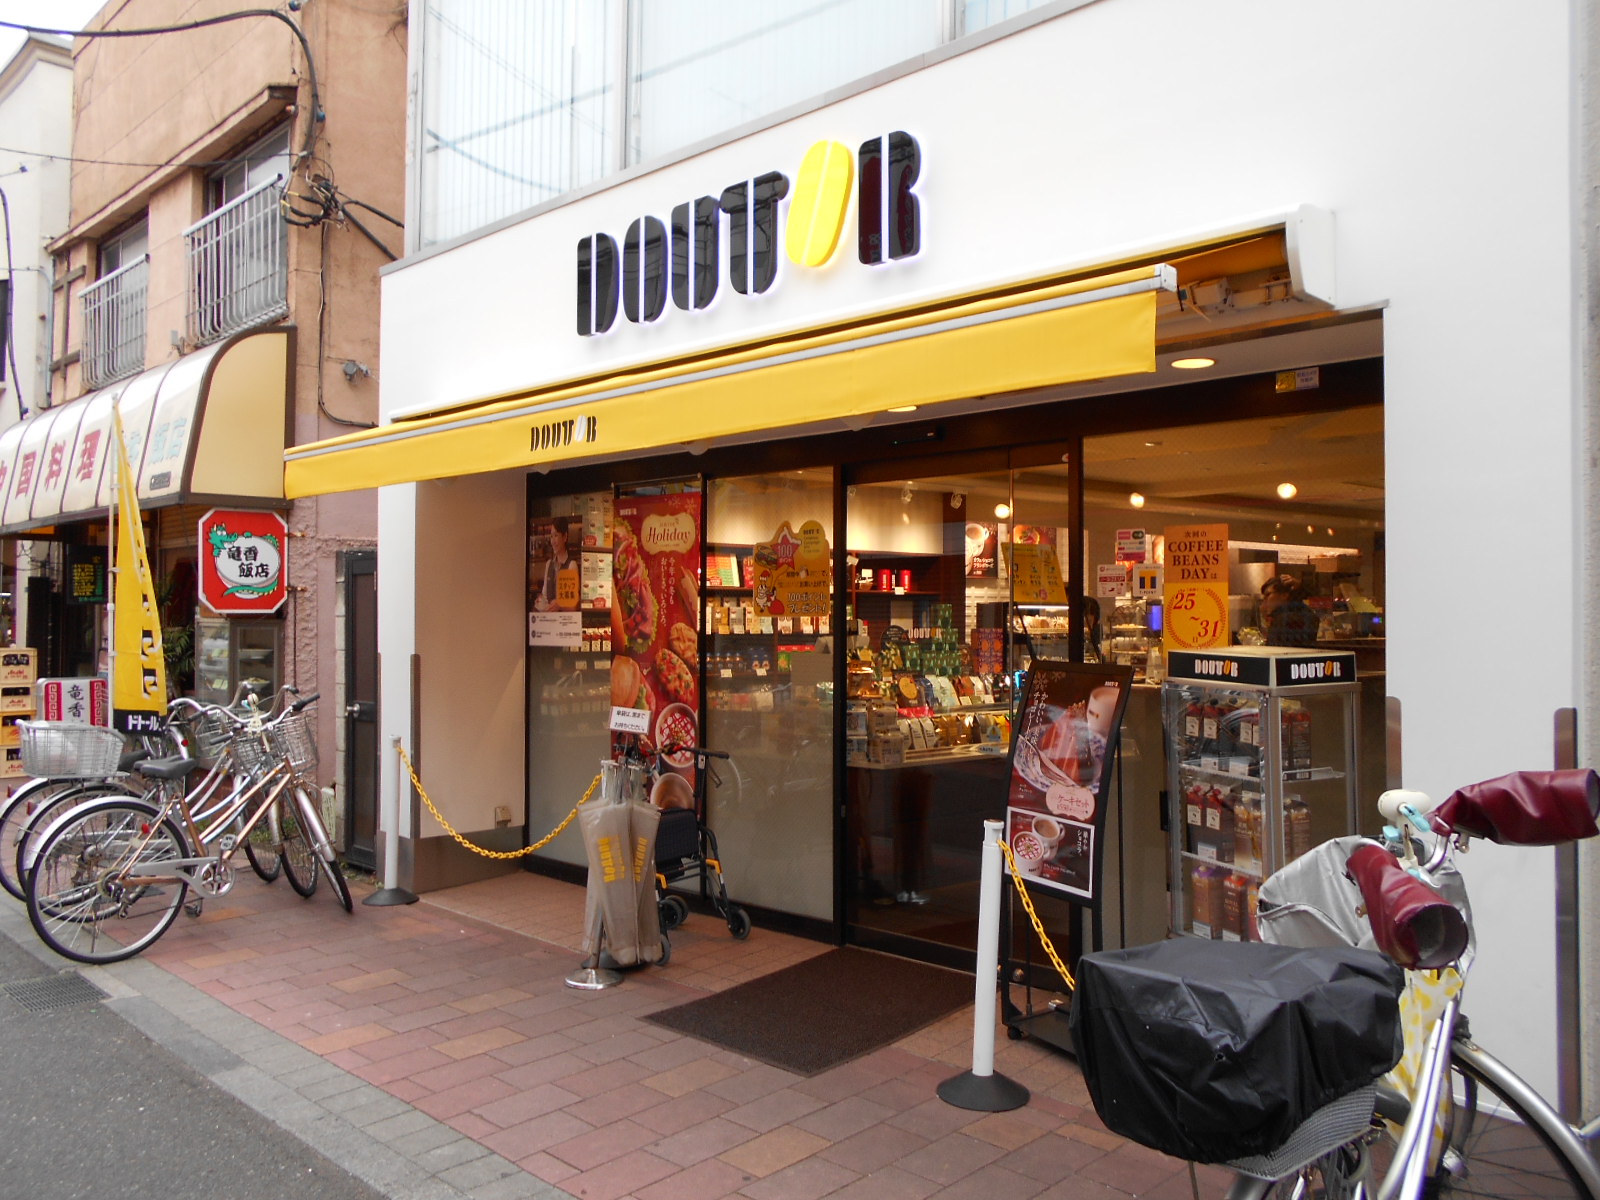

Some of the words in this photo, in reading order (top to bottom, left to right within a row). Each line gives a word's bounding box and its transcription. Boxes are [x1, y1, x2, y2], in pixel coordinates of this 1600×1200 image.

[577, 130, 922, 336] DOUTOR
[530, 415, 597, 452] DOUTOR
[647, 527, 690, 545] Holiday
[227, 546, 258, 561] 竜香
[778, 545, 793, 558] 100
[1168, 540, 1224, 553] COFFEE
[1172, 554, 1219, 566] BEANS
[238, 562, 269, 578] 飯店
[1181, 568, 1210, 580] DAY
[1173, 592, 1196, 610] 25
[1198, 620, 1220, 638] 31
[1194, 659, 1239, 677] DOUTOR
[1291, 660, 1342, 680] DOUTOR
[67, 685, 85, 722] 竜香
[128, 715, 160, 731] ドトール
[1058, 794, 1090, 808] ケーキセット
